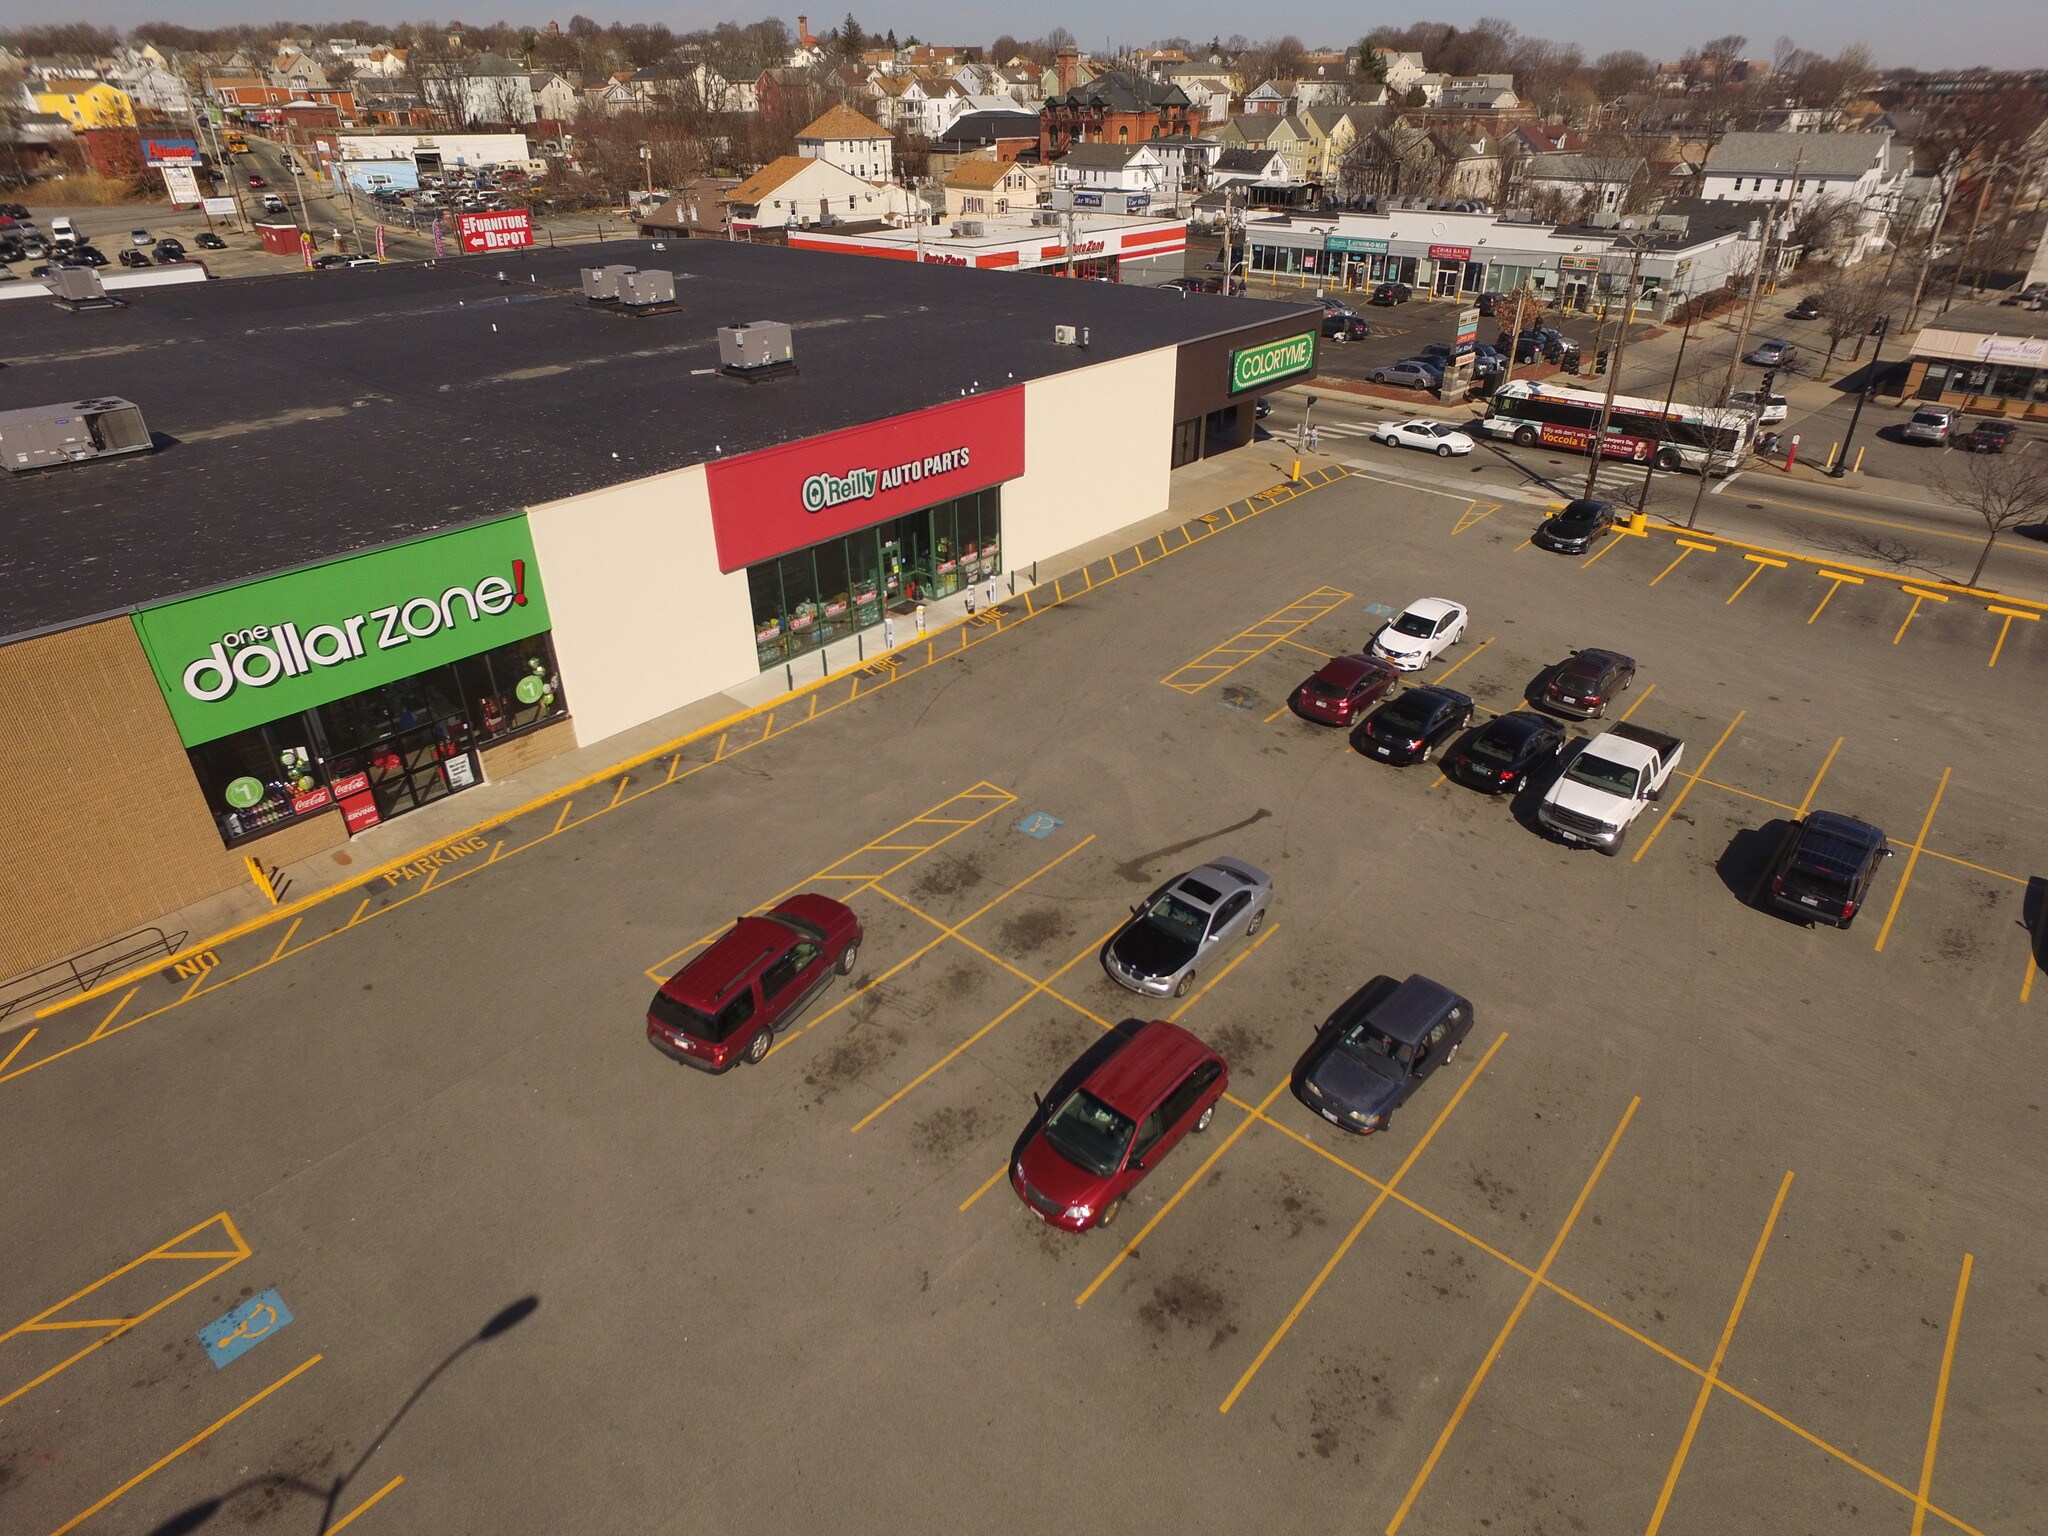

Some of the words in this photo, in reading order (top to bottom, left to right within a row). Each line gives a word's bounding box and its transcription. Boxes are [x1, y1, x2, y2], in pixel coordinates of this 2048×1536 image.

[1085, 197, 1100, 205] Wash
[462, 217, 471, 236] THE
[469, 215, 528, 233] FURNITURE
[485, 231, 526, 247] DEPOT
[1242, 341, 1307, 379] COLORTYME
[1543, 432, 1578, 447] Voccola
[802, 468, 878, 512] O'Reilly
[881, 461, 921, 490] AUTO
[924, 447, 970, 477] PARTS
[968, 606, 1009, 628] LANE
[182, 614, 368, 702] dollar
[370, 559, 529, 650] zone!
[223, 625, 270, 649] one
[863, 656, 903, 676] FIRE
[295, 791, 326, 810] Coca-Cola
[384, 835, 489, 888] PARKING
[174, 951, 221, 980] NO
